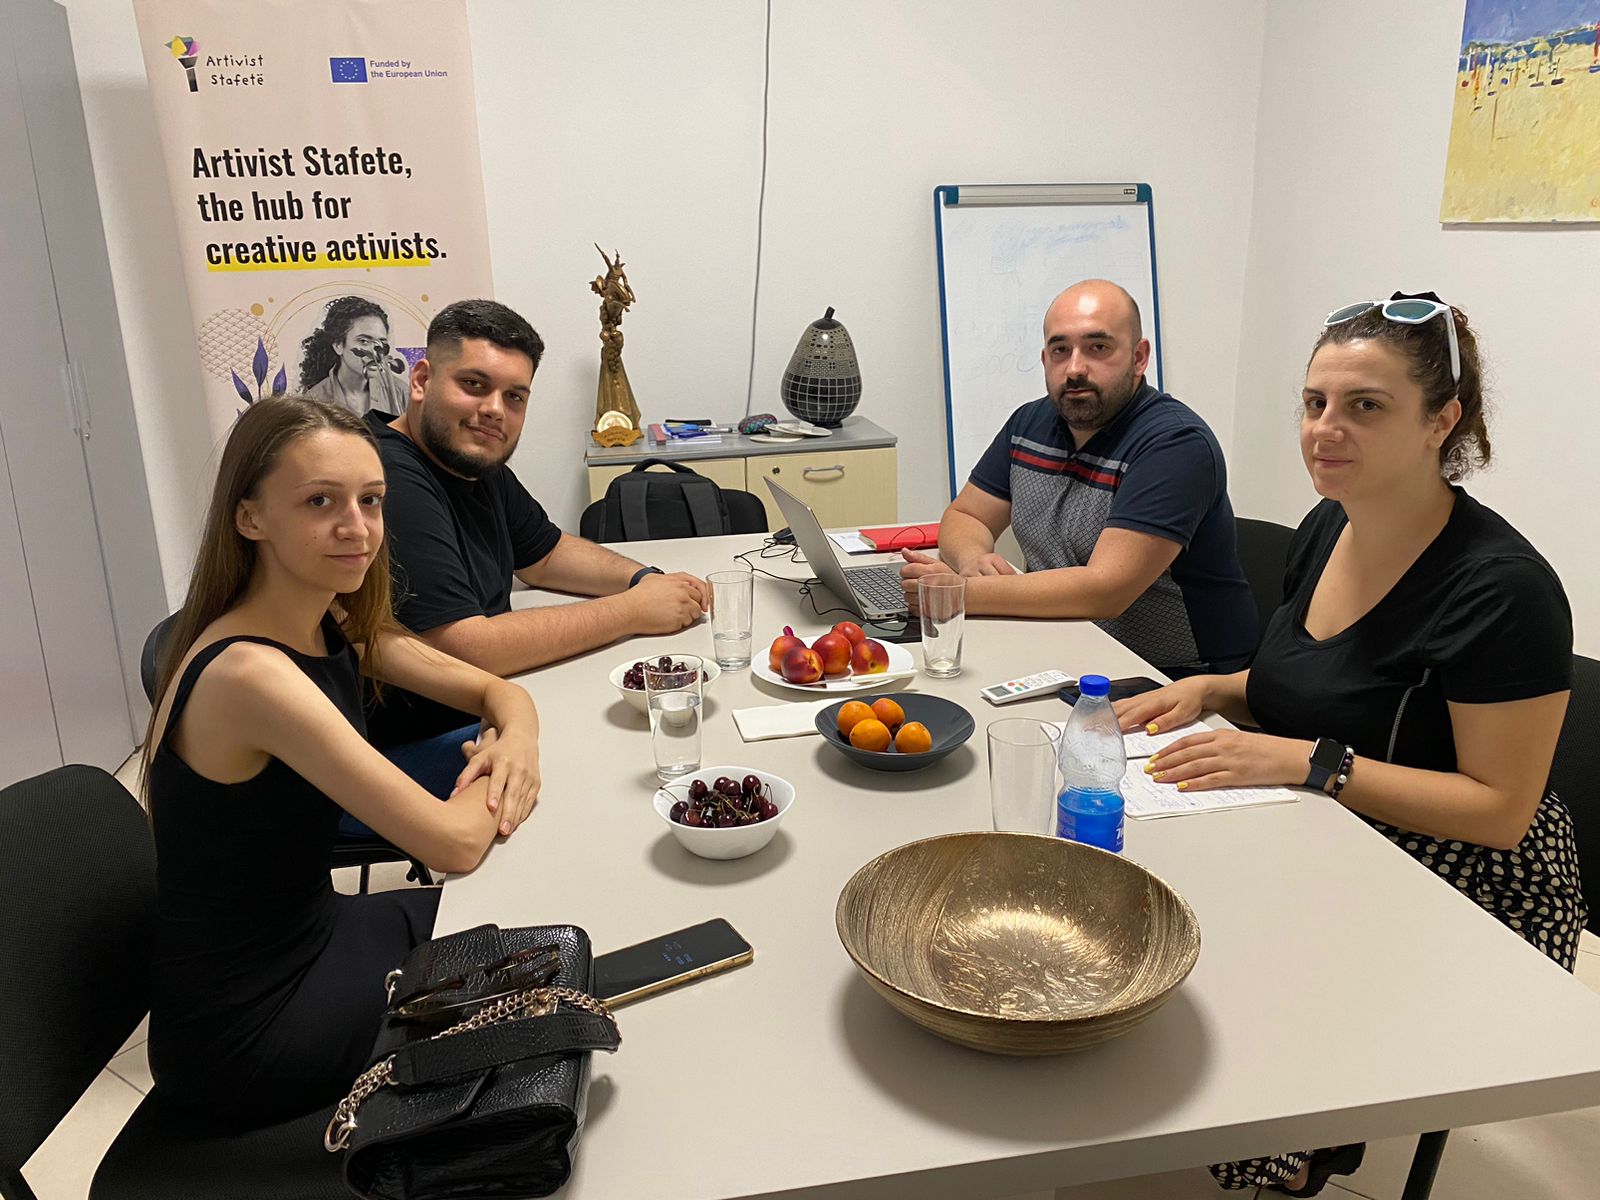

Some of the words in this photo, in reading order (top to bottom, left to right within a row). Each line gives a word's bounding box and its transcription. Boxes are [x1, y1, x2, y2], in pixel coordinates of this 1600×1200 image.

[206, 54, 264, 67] Artivist
[369, 60, 399, 68] Funded
[401, 60, 411, 69] by
[211, 73, 264, 86] Stafetë
[371, 70, 384, 78] the
[385, 70, 423, 79] European
[424, 69, 448, 77] Union
[193, 148, 296, 178] Artivist
[303, 146, 412, 179] Stafete,
[197, 192, 244, 222] the
[252, 190, 304, 221] hub
[312, 191, 351, 219] for
[206, 235, 317, 265] creative
[326, 232, 447, 261] activists.
